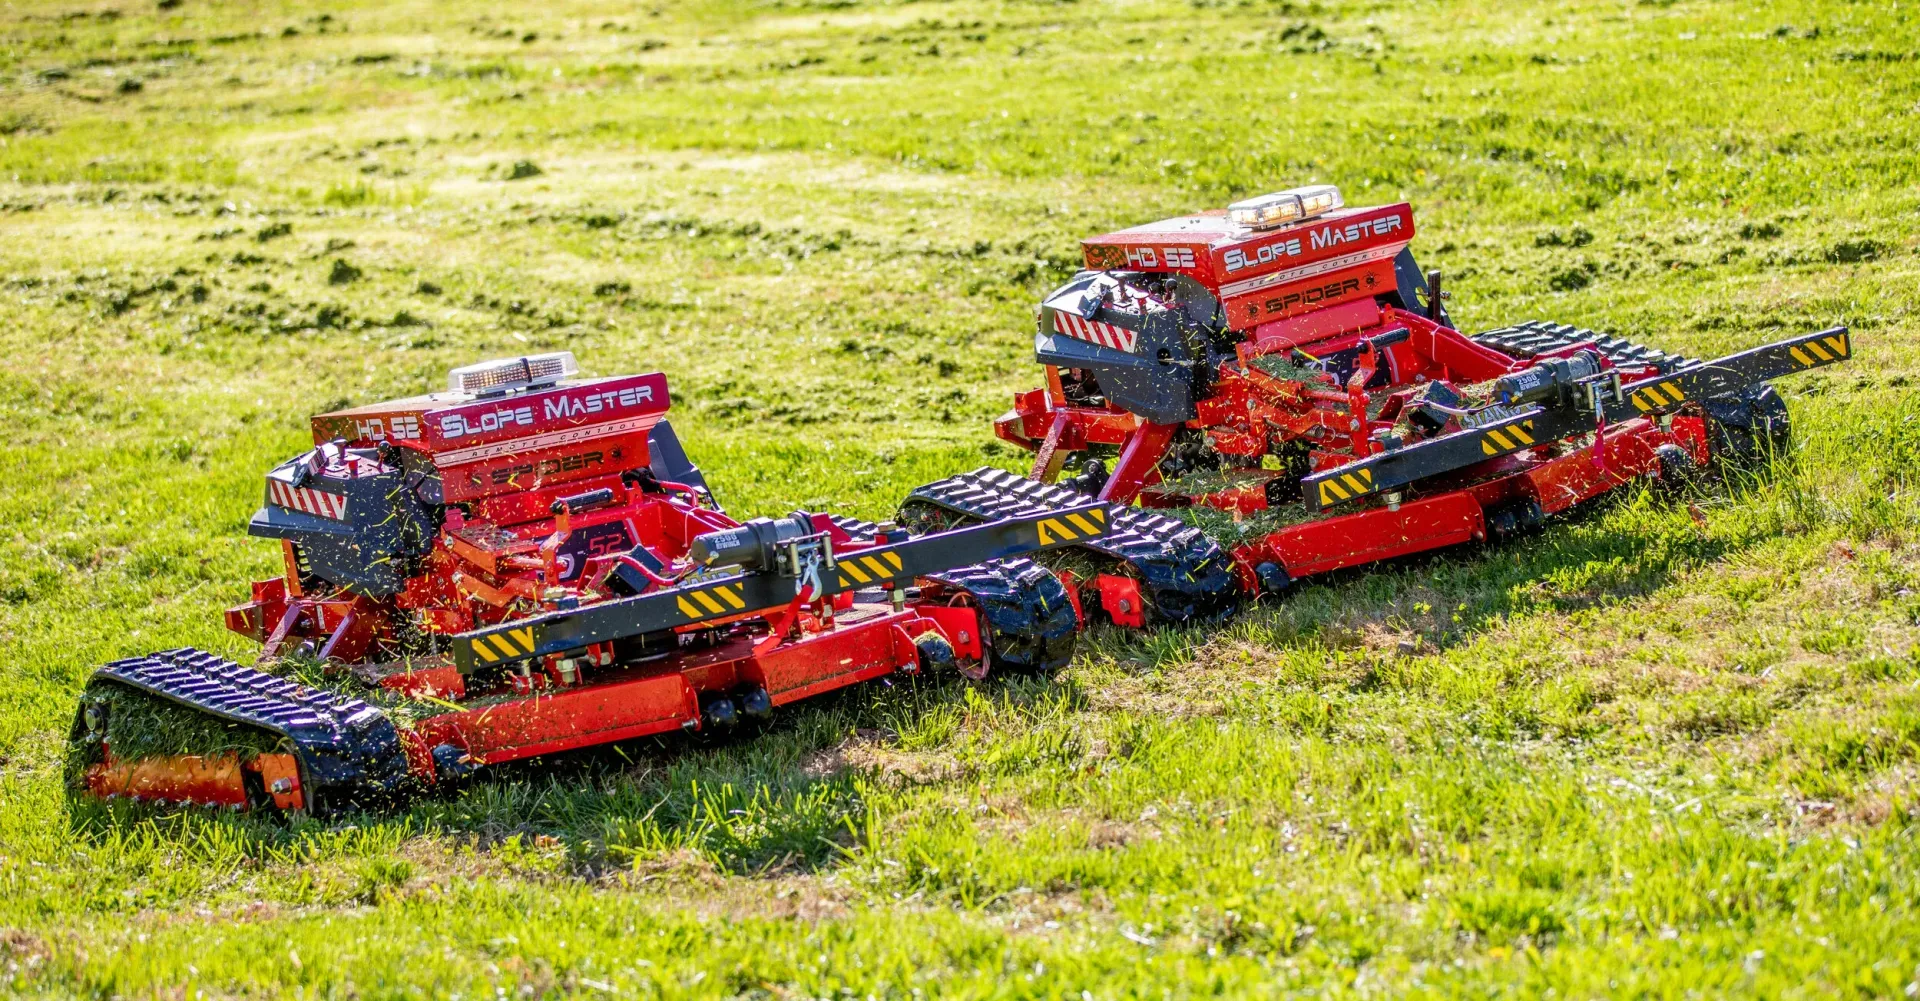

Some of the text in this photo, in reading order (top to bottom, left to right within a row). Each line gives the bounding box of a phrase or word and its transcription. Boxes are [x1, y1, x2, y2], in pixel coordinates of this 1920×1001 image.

[1124, 247, 1196, 268] HD 52
[1223, 214, 1402, 272] SLOPE MASTER
[1322, 249, 1388, 269] CONTROL
[440, 385, 654, 439] SLOPE MASTER
[356, 416, 421, 441] HD 52
[472, 422, 637, 457] REMOTE CONTROL
